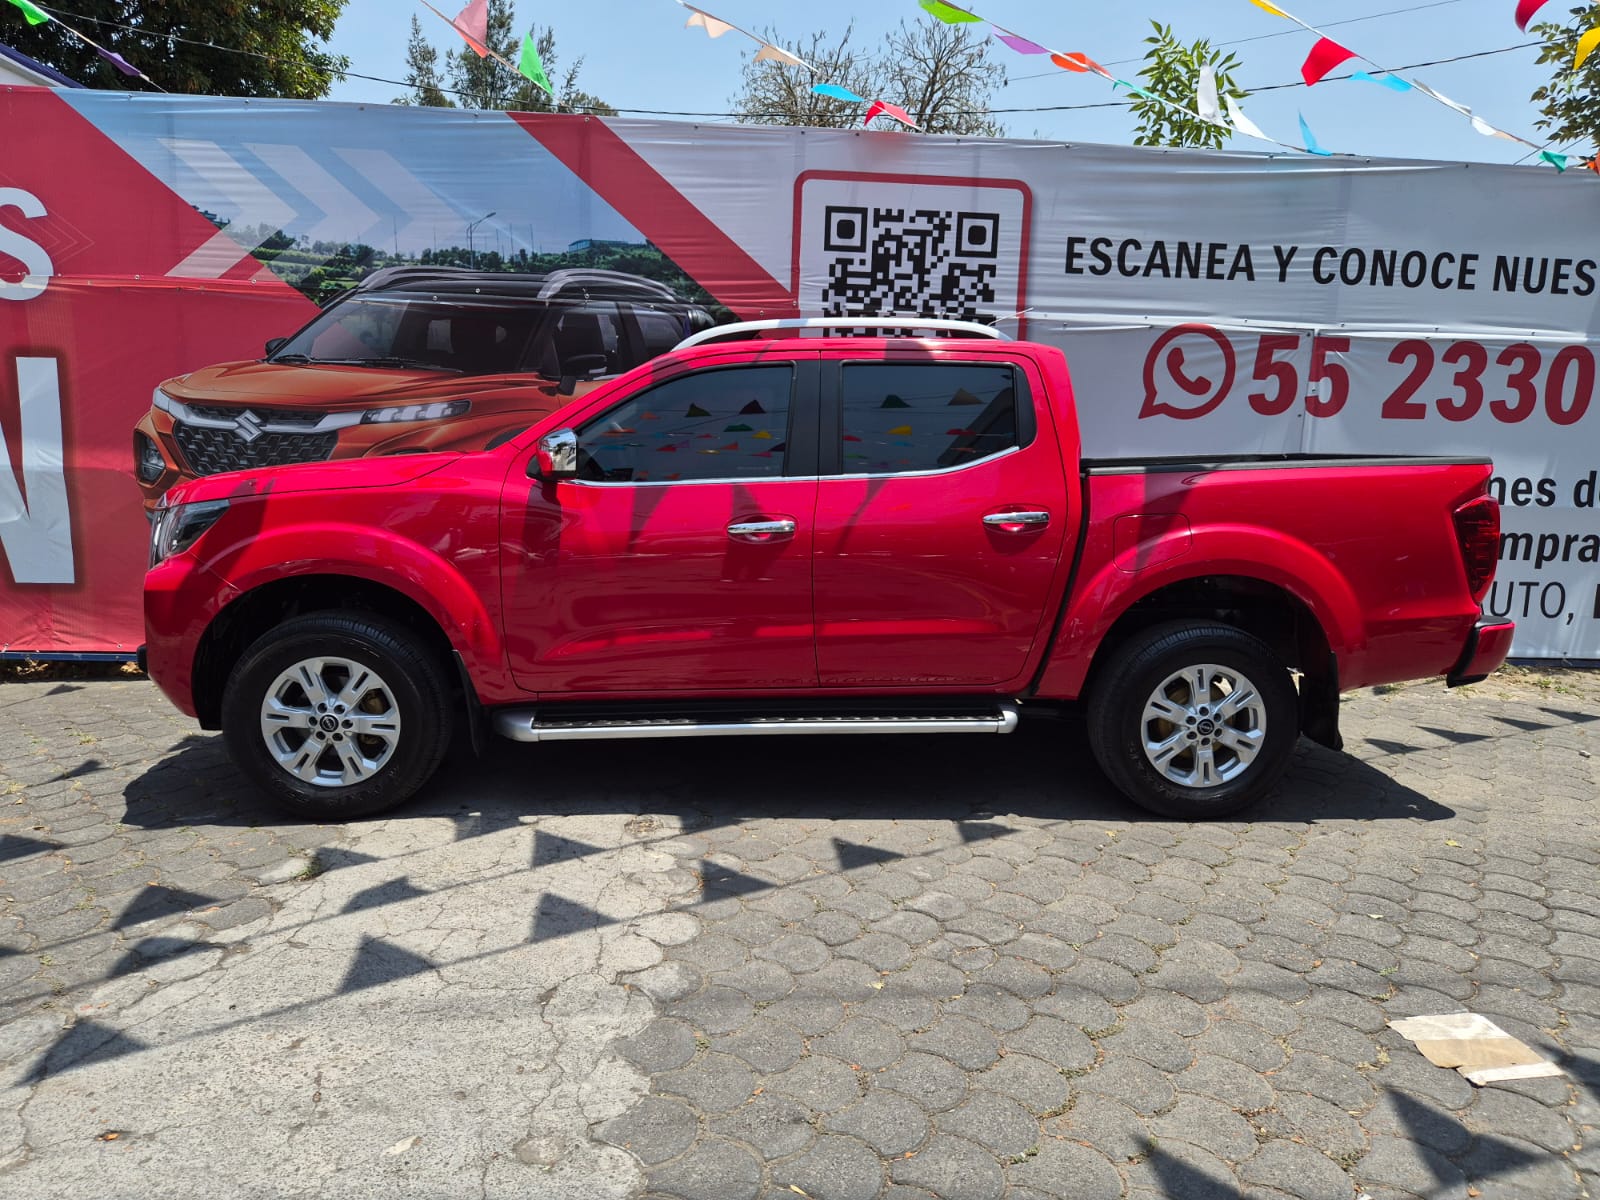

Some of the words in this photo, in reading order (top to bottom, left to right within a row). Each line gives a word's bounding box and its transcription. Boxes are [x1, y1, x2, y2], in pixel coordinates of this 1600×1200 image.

[1064, 236, 1255, 281] ESCANEA
[1273, 245, 1298, 282] Y
[1312, 246, 1479, 290] CONOCE
[1493, 255, 1597, 296] NUES
[1248, 334, 1350, 418] 55
[1381, 338, 1596, 426] 2330
[1481, 580, 1574, 625] UTO,
